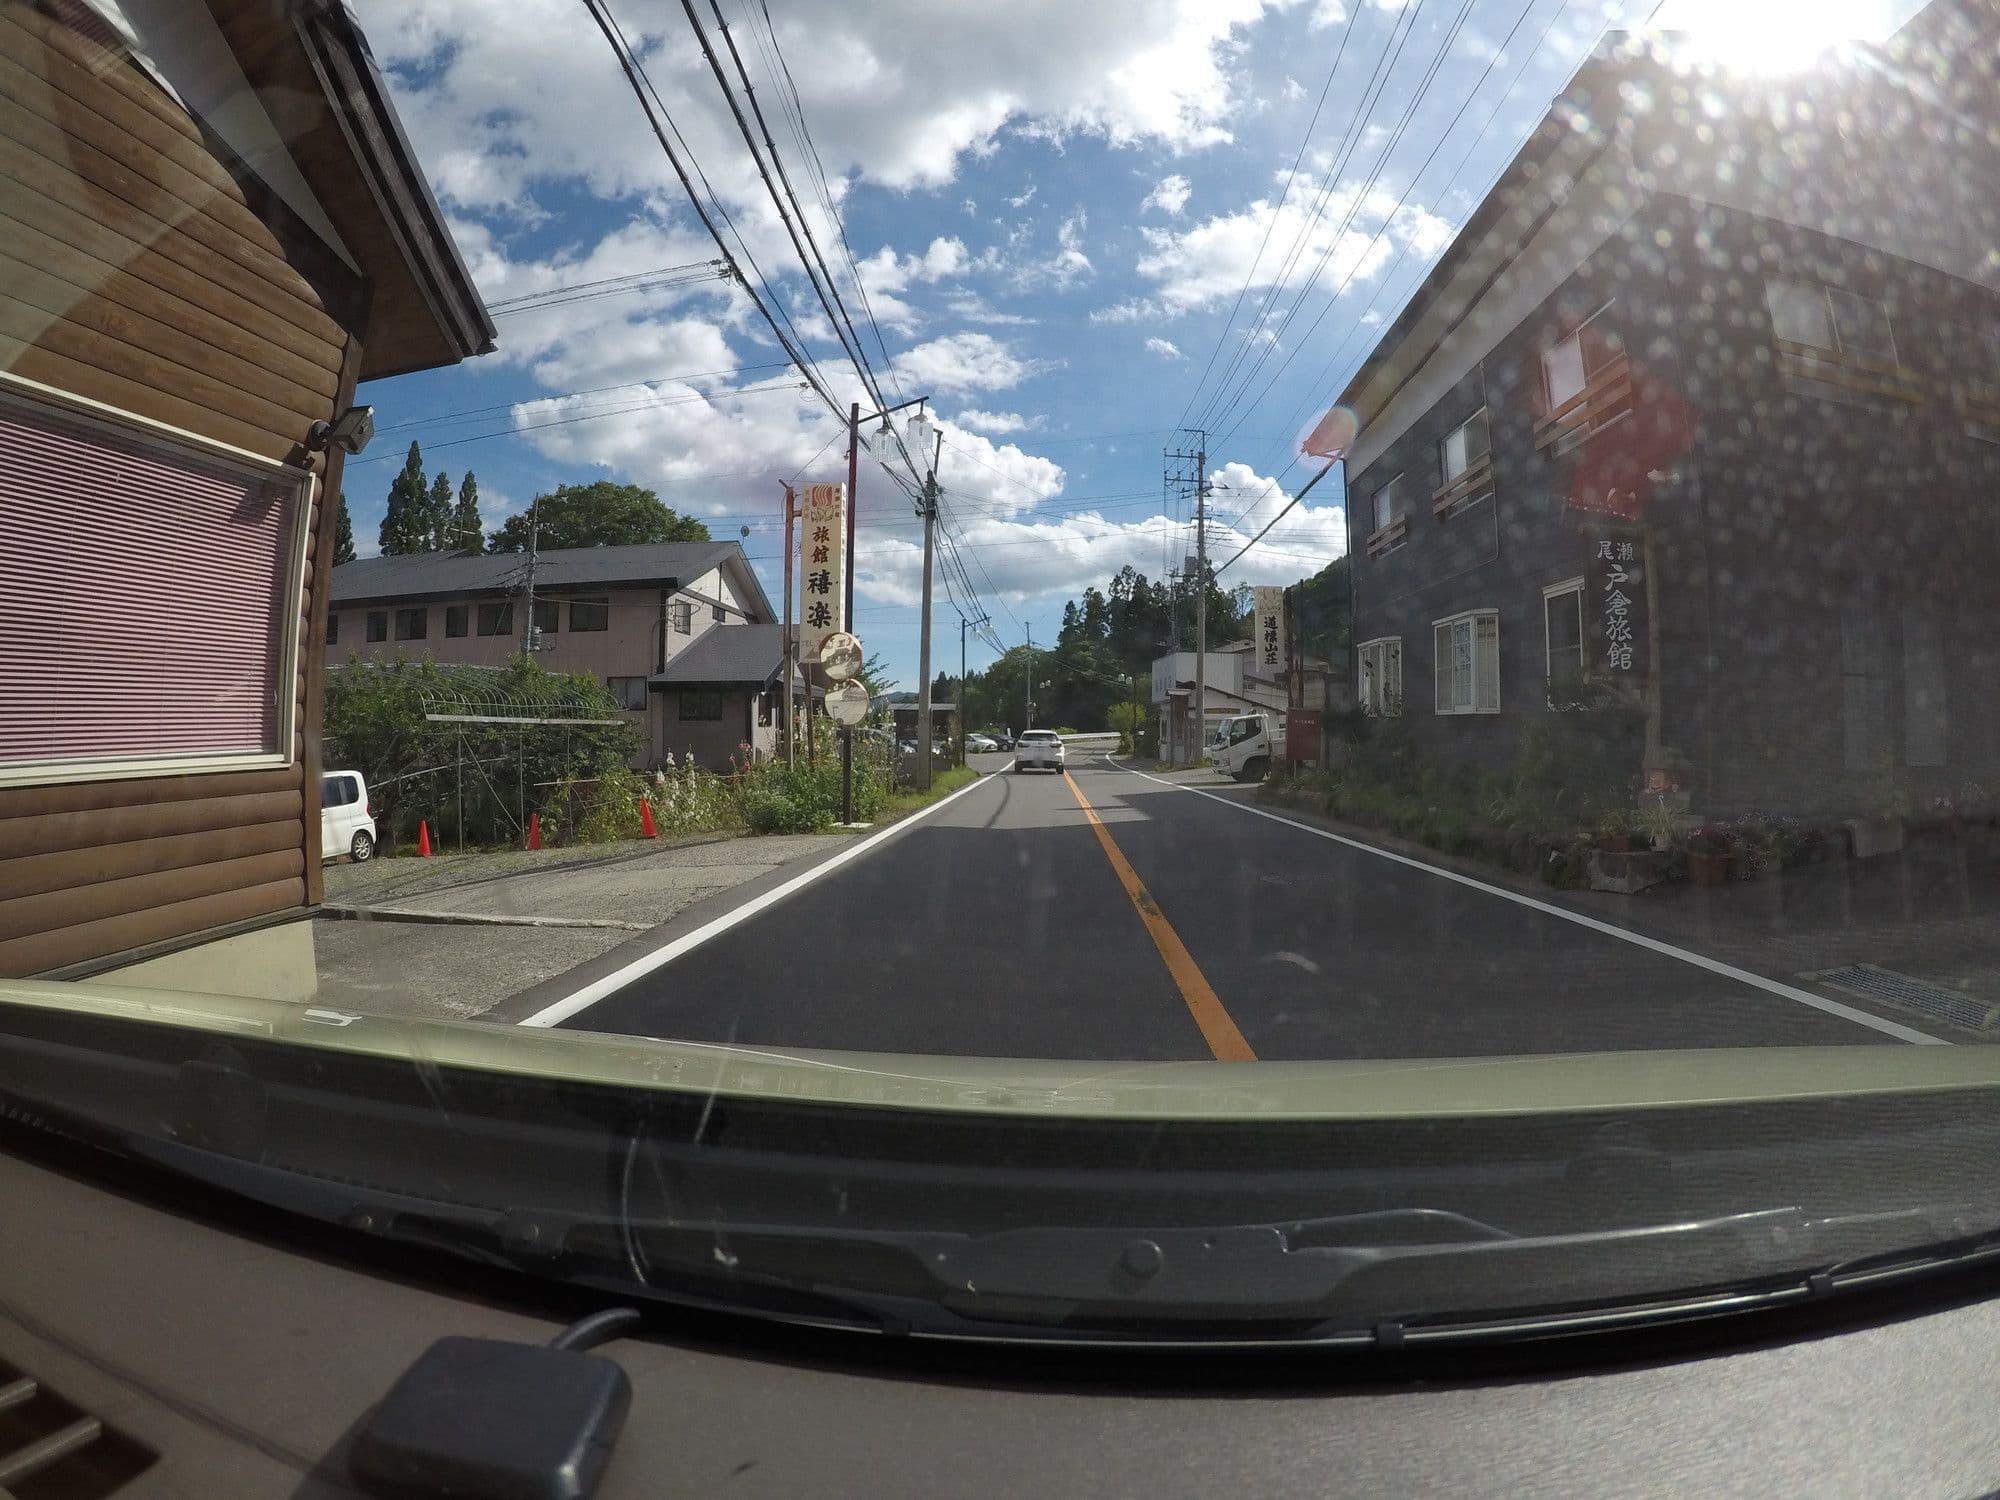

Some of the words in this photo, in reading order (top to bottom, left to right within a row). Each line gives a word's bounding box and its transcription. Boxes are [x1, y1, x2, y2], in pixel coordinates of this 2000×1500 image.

[1597, 540, 1634, 561] 尾瀬
[1604, 563, 1633, 670] 戸倉旅館
